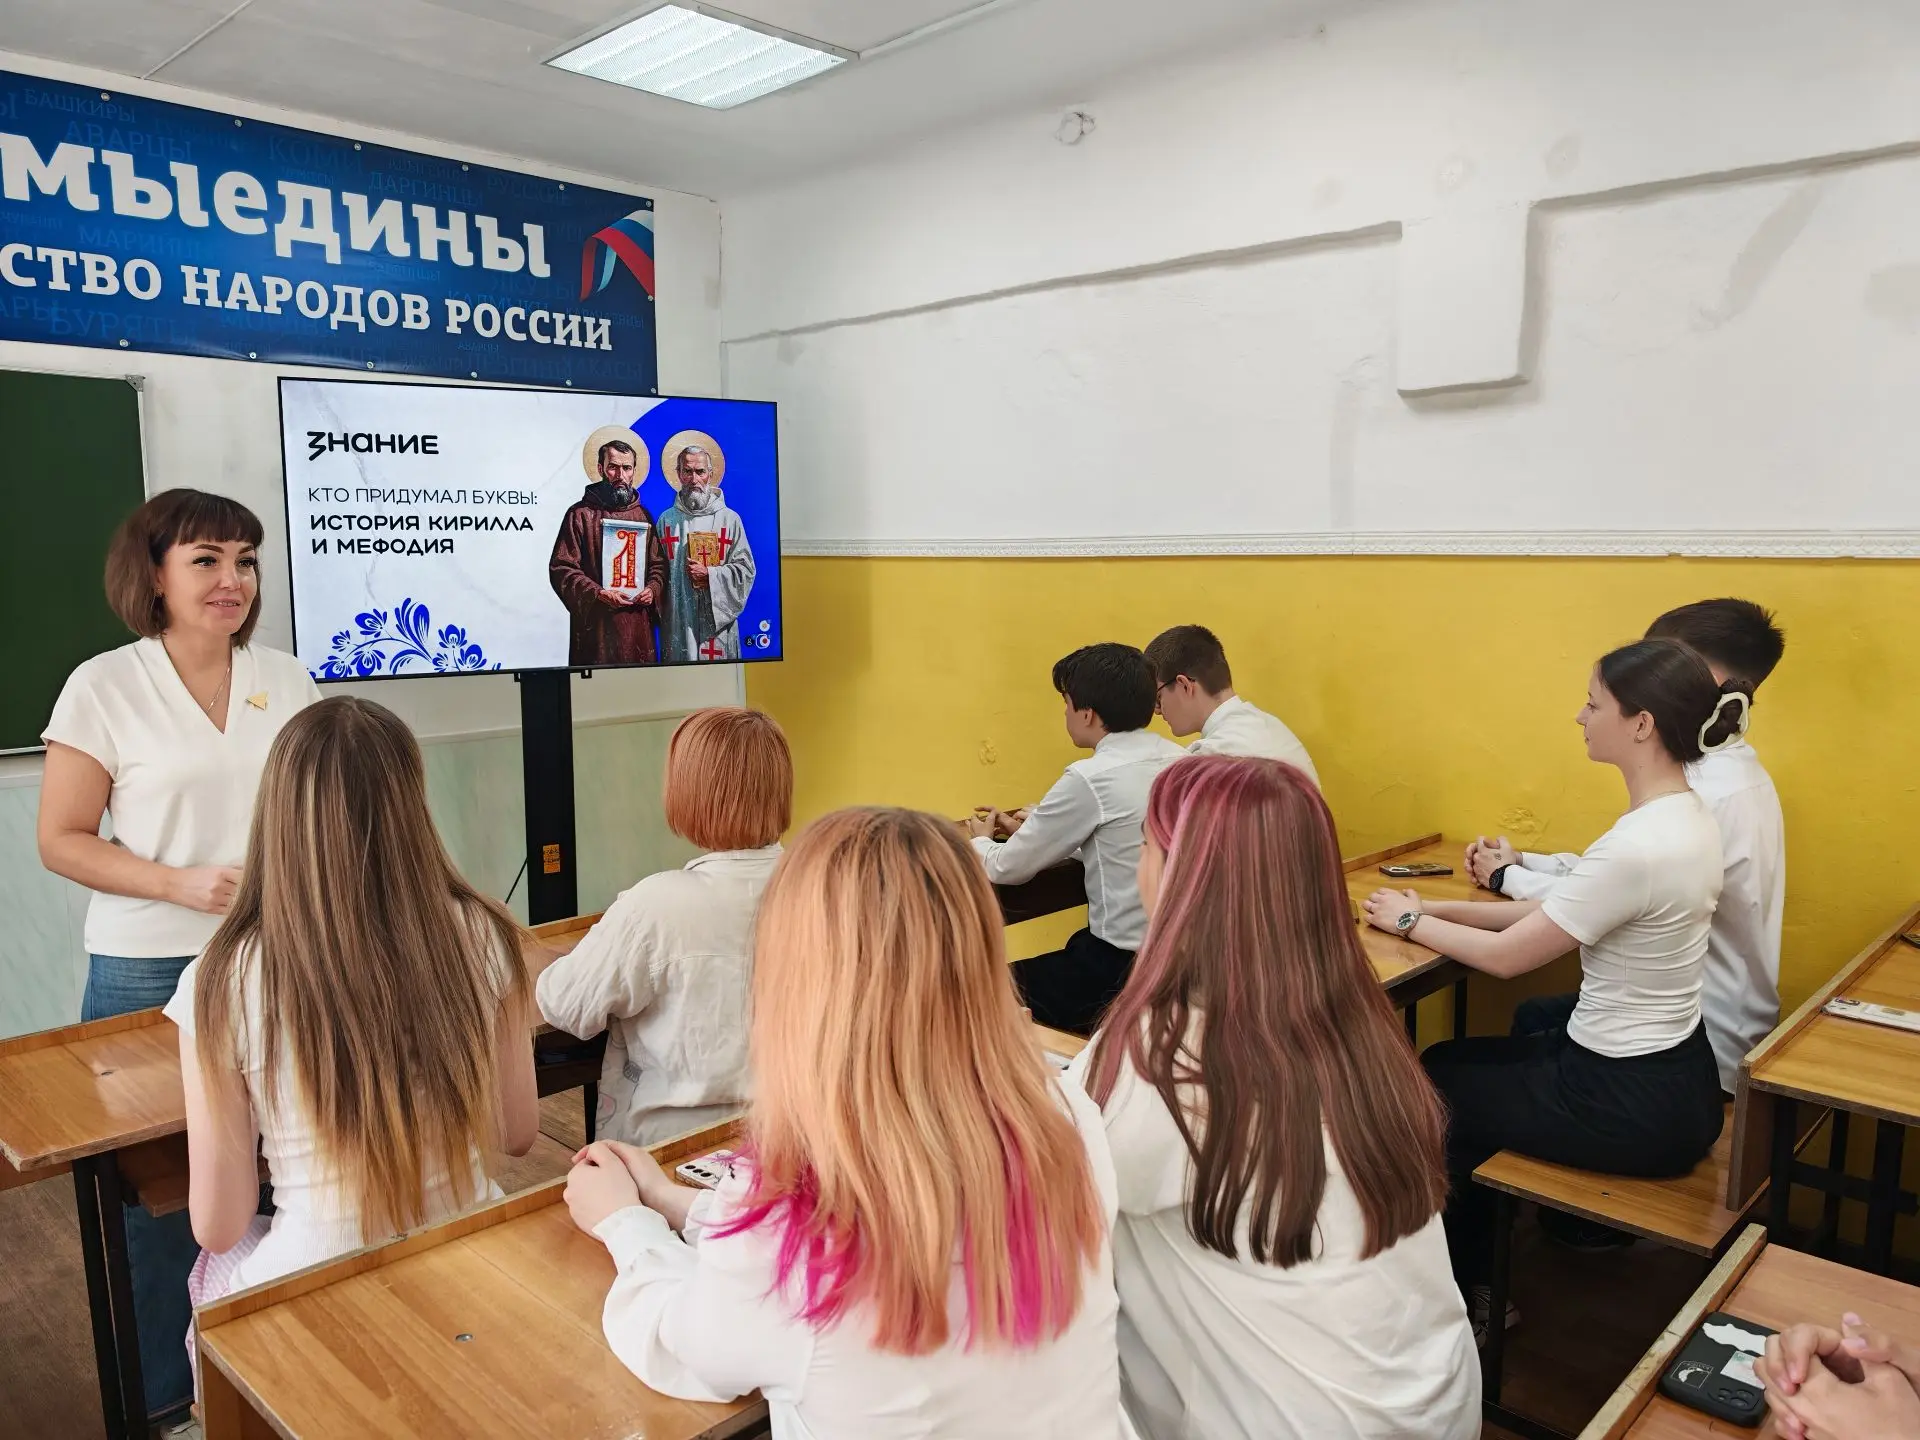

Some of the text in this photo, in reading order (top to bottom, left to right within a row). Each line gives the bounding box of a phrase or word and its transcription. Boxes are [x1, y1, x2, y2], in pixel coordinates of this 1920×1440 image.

[0, 243, 162, 301] СТВО
[181, 264, 431, 333] НАРОДОВ
[445, 298, 613, 351] РОССИИ
[308, 488, 538, 505] КТО ПРИДУМАЛ БУКВЫ:
[310, 514, 534, 532] ИСТОРИЯ КИРИЛЛА
[312, 538, 454, 556] И МЕФОДИЯ
